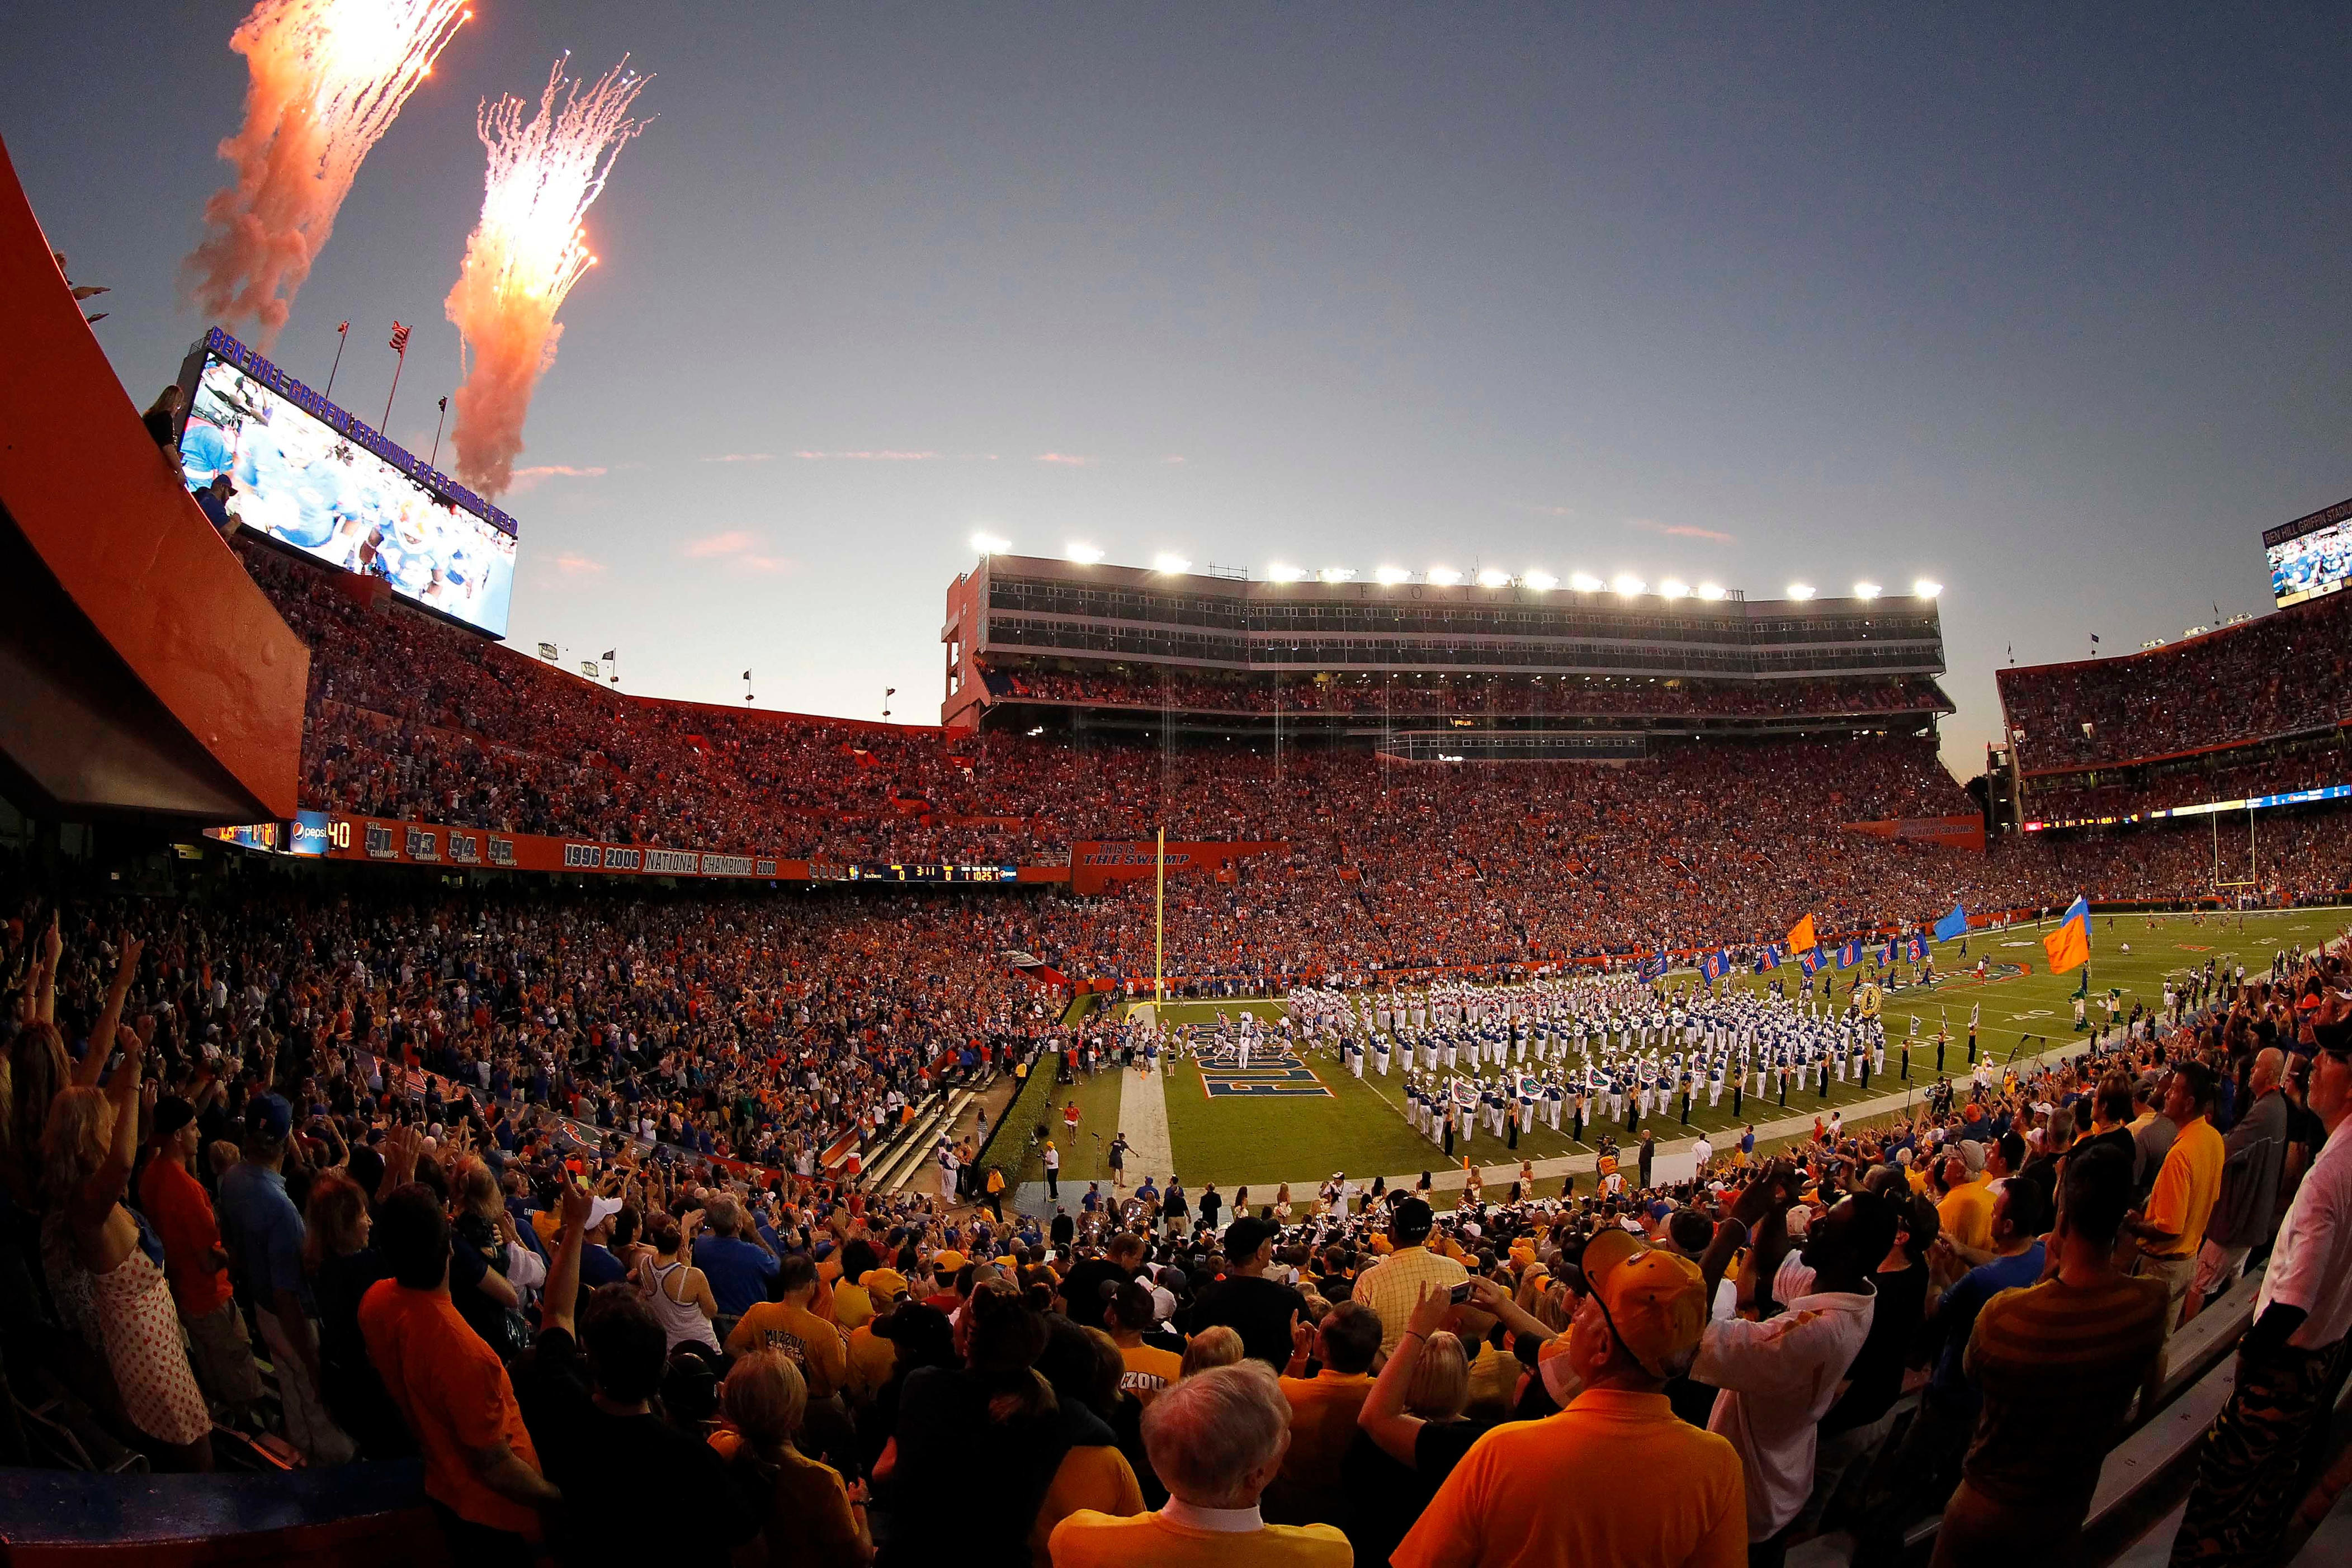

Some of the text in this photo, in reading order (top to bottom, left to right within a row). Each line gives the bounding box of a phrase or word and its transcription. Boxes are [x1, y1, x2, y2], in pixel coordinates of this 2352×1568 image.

[209, 326, 519, 536] BEN HILL GRIFFIN STADIUM AT FLORIDA FIELD
[2265, 501, 2352, 544] BEN HILL GRIFFIN STADIU
[305, 827, 328, 839] pepsi
[328, 821, 350, 848] 40
[365, 828, 393, 851] 91
[370, 849, 399, 858] CHAMPS
[406, 833, 436, 855] 93
[448, 837, 476, 858] 94
[488, 840, 513, 860] 95
[1099, 843, 1123, 854] THIS
[415, 853, 441, 861] CHAMPS
[565, 844, 777, 876] 1996 2006 NATIONAL CHAMPIONS 2008
[1083, 854, 1191, 866] THE SWAMP
[899, 870, 905, 881] 0
[917, 866, 934, 876] 3:11
[946, 871, 951, 881] 0
[1909, 939, 1920, 961] S
[1707, 955, 1720, 979] G
[1804, 952, 1818, 973] T
